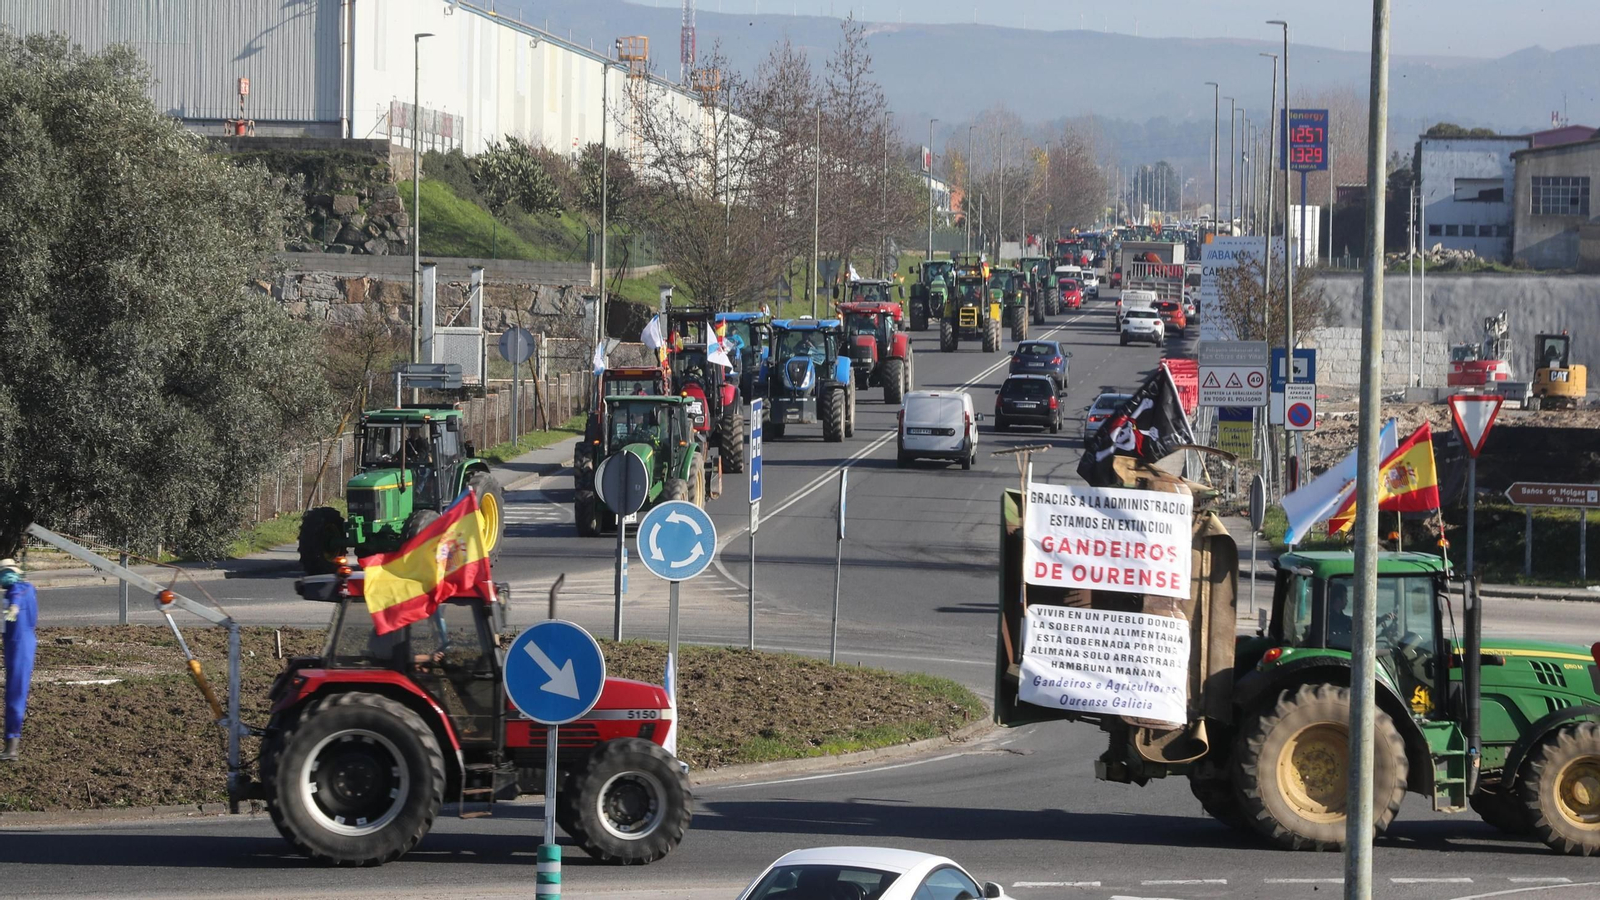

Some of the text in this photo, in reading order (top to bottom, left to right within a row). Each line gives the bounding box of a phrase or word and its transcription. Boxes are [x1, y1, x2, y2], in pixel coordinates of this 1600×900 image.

[1290, 112, 1324, 121] lenergy
[1551, 371, 1568, 382] CAT
[1031, 492, 1076, 507] GRACIAS
[1078, 496, 1085, 507] A
[1089, 496, 1101, 508] LA
[1561, 488, 1585, 497] Molgas
[1050, 514, 1172, 535] ESTAMOS EN EXTINCION
[1041, 536, 1177, 562] GANDEIROS
[1035, 562, 1180, 590] DE OURENSE
[1037, 608, 1181, 630] VIVIR EN UN PUEBLO DONDE
[1033, 621, 1045, 629] LA
[1114, 627, 1184, 644] ALIMENTARIA
[1031, 646, 1079, 657] ALIMAÑA
[1083, 651, 1110, 660] SOLO
[1066, 636, 1130, 649] GOBERNADA
[1134, 642, 1154, 652] POR
[1158, 645, 1178, 655] UNA
[1051, 661, 1162, 678] HAMBRUNA MAÑANA
[1033, 676, 1092, 689] Gandeiros
[1105, 679, 1177, 694] Agricultores
[1059, 694, 1152, 710] Ourense Galicia
[628, 710, 656, 719] 5150
